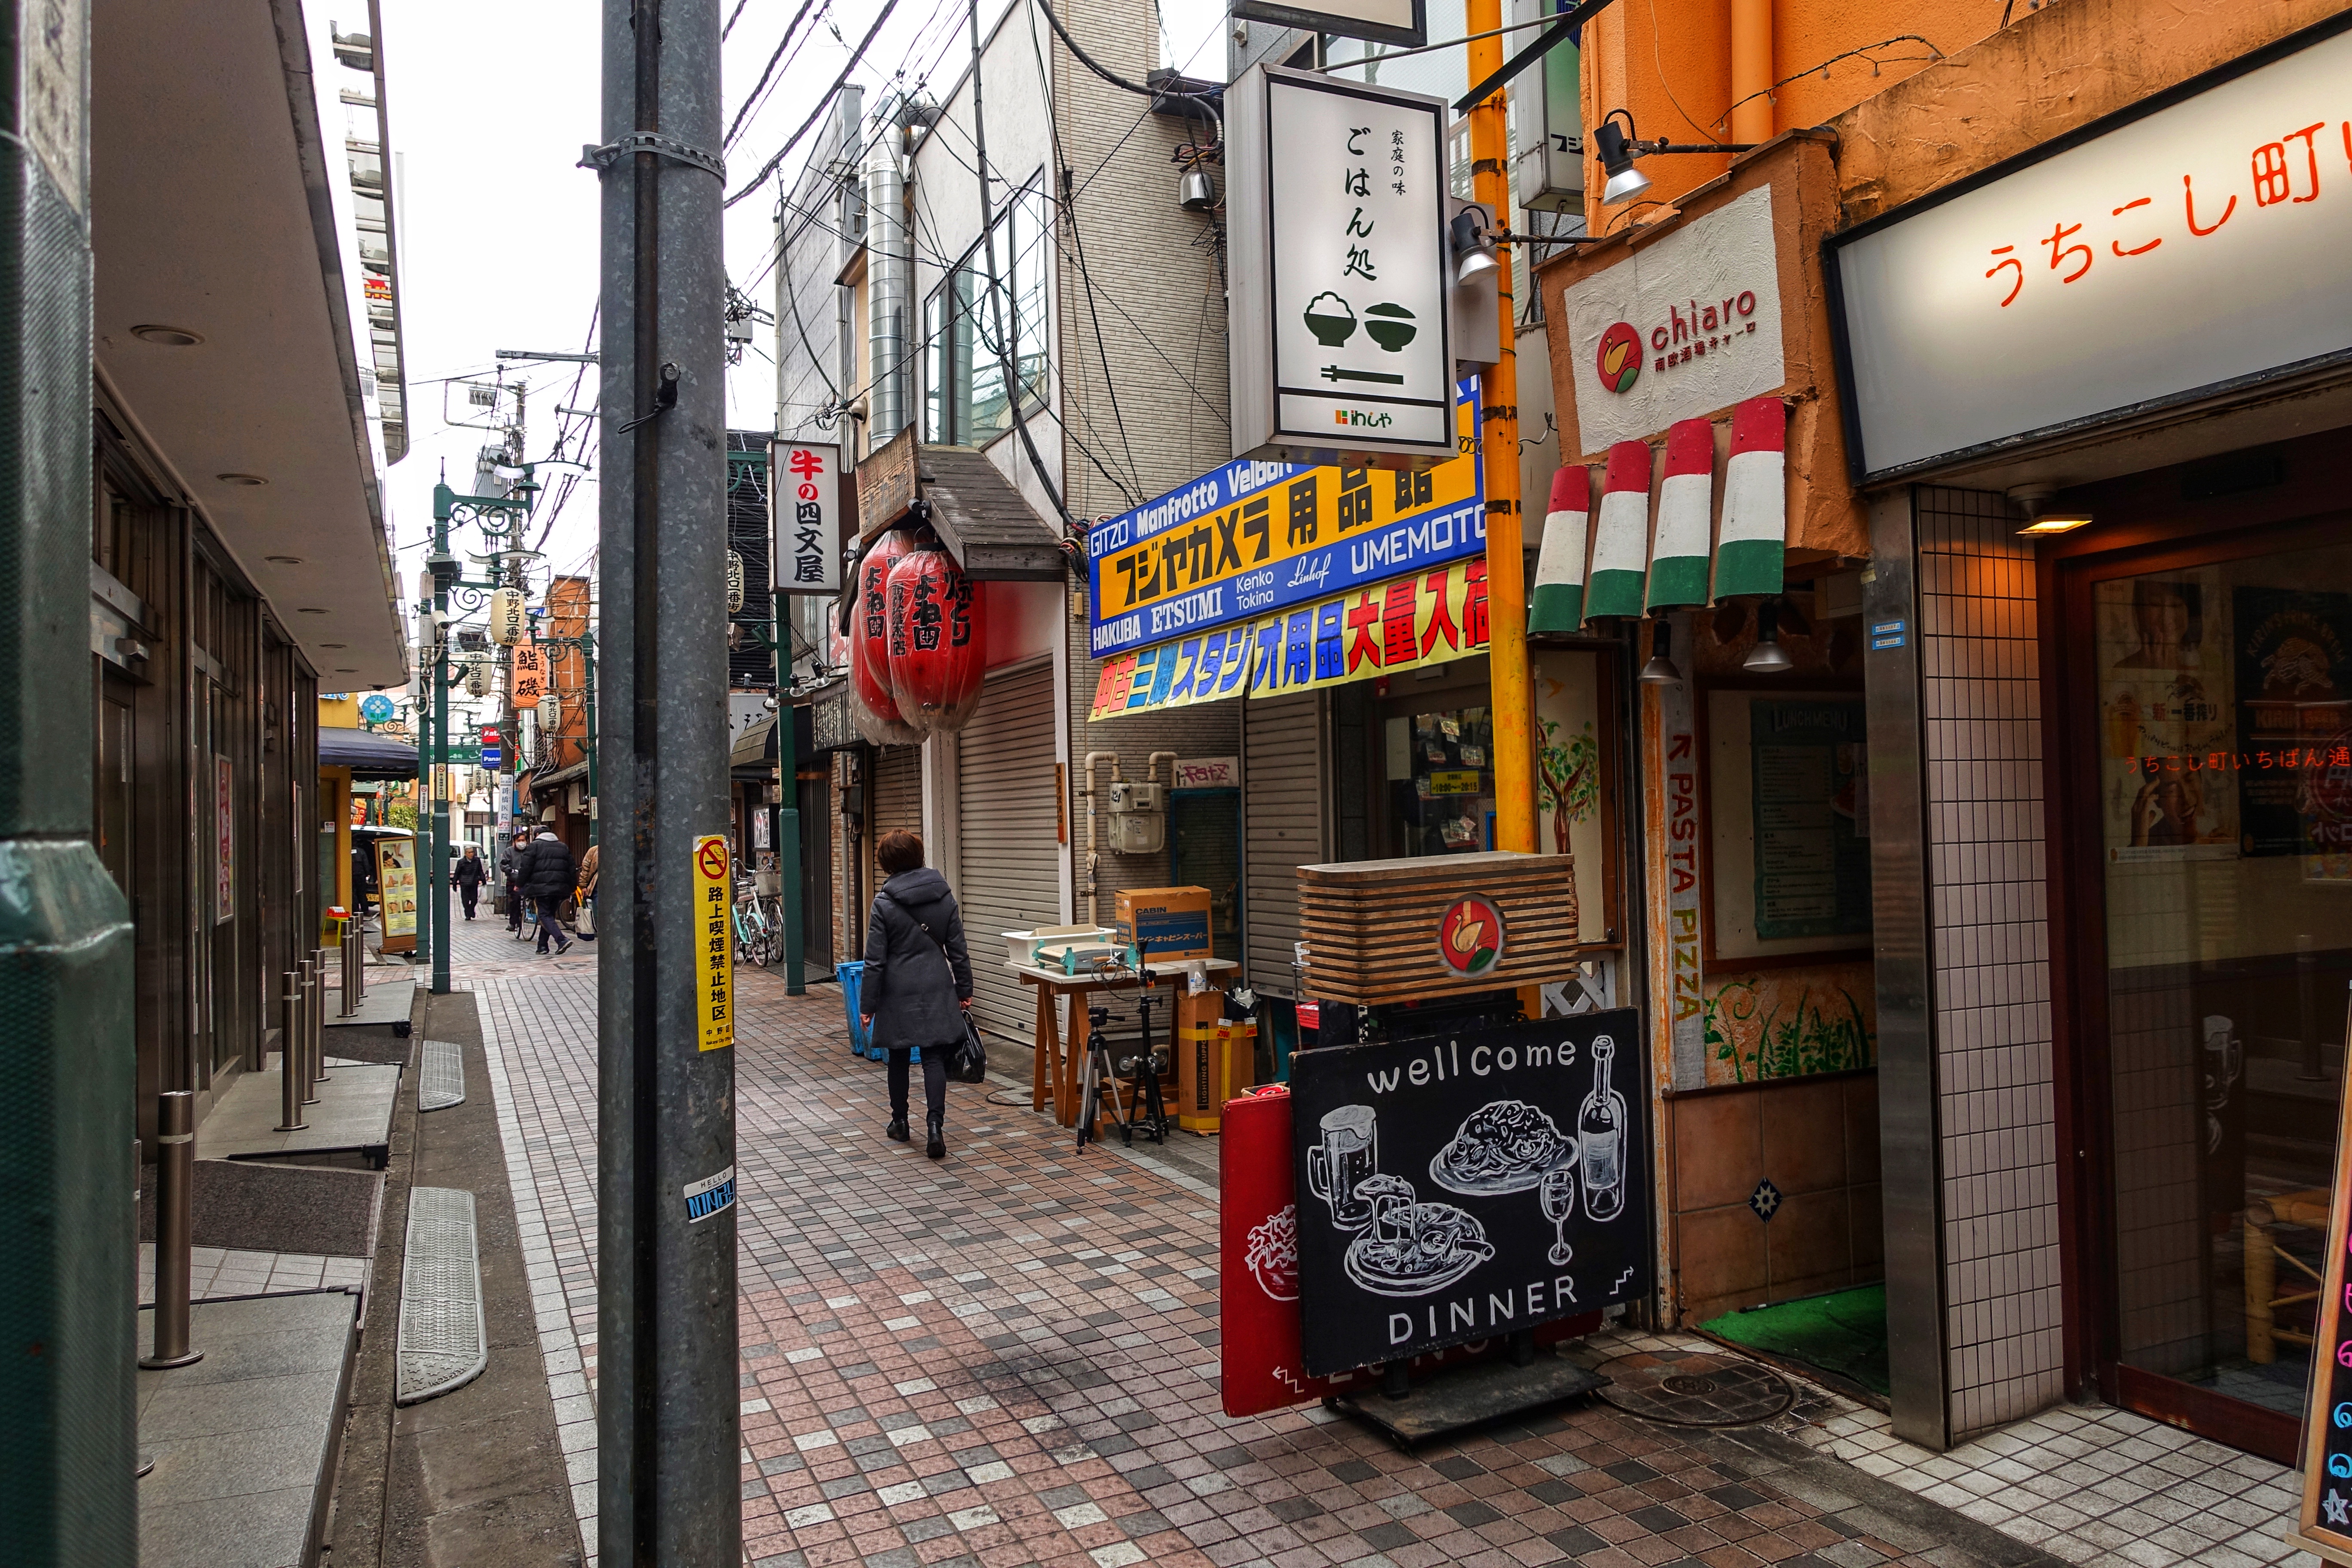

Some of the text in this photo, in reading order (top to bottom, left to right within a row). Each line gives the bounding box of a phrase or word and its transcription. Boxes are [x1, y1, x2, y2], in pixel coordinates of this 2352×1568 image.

[1391, 129, 1406, 196] 家庭の味
[1344, 126, 1378, 282] ごはん処
[1651, 290, 1756, 350] chiaro
[789, 449, 825, 584] 牛の四文屋
[1090, 519, 1129, 558] GITZO
[1136, 479, 1218, 539] Manfrotto
[1116, 494, 1270, 606] フジヤカメラ
[1287, 553, 1332, 589] Linhof
[1236, 570, 1274, 594] Kenko
[1236, 589, 1274, 612] Tokina
[503, 590, 520, 644] 中野北口一番街
[1092, 585, 1224, 652] HAKUBA ETSUMI
[2125, 746, 2351, 774] うちこし町いちばん通
[1668, 774, 1700, 1022] PASTA PIZZA
[708, 886, 726, 1022] 路上喫煙禁止地区
[706, 1025, 729, 1036] 中野区
[1368, 1040, 1576, 1094] wellcome
[701, 1172, 726, 1188] HELLO
[1389, 1276, 1578, 1344] DINNER
